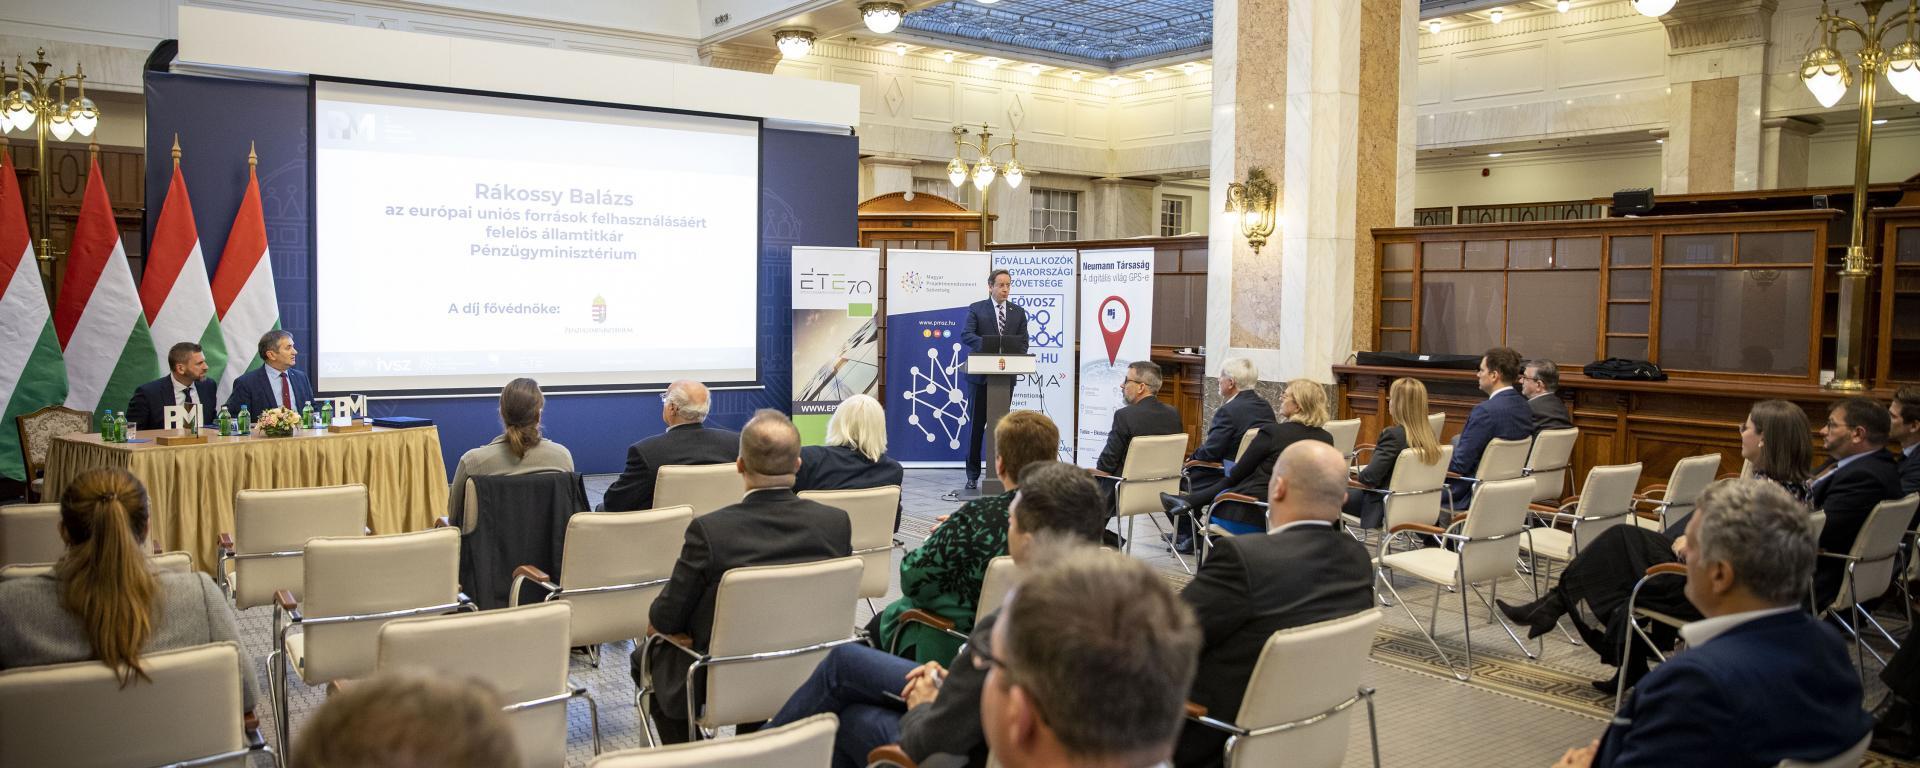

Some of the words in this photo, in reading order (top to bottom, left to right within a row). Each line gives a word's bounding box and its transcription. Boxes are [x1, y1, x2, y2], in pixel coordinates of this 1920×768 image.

[475, 183, 563, 205] Rákossy
[570, 188, 634, 206] Balázs
[385, 205, 404, 216] az
[409, 206, 472, 220] európai
[478, 207, 521, 221] uniós
[524, 209, 588, 224] források
[592, 212, 707, 228] felhasználásáért
[542, 227, 624, 242] államtitkár
[470, 244, 637, 260] Pénzügyminisztérium
[995, 255, 1074, 265] FŐVÁLLALKOZÓK
[1083, 261, 1115, 271] Neumann
[1117, 260, 1150, 271] Társaság
[1009, 267, 1073, 276] GYARORSZÁGI
[1010, 277, 1063, 287] ZÖVETSÉGE
[1083, 274, 1088, 282] A
[1089, 273, 1111, 284] digitális
[1113, 273, 1127, 283] világ
[1129, 272, 1150, 282] GPS-e
[1011, 295, 1056, 307] FŐVOSZ
[448, 303, 459, 315] A
[462, 302, 480, 317] díj
[484, 301, 561, 315] fővédnöke:
[1036, 353, 1059, 364] .HU
[1016, 374, 1061, 388] PMA
